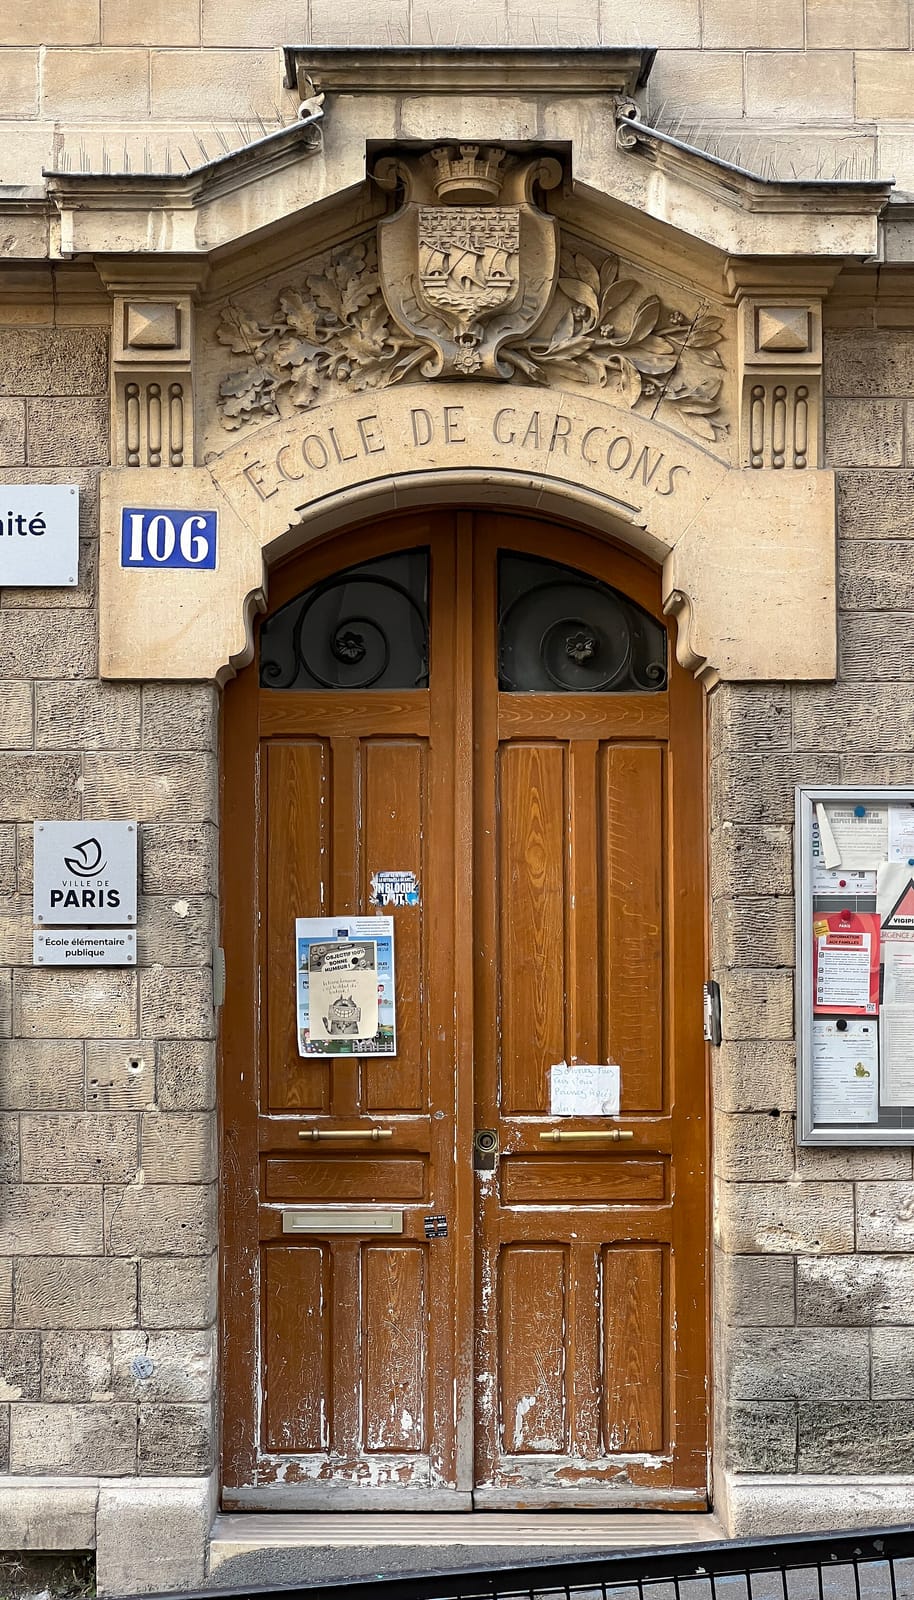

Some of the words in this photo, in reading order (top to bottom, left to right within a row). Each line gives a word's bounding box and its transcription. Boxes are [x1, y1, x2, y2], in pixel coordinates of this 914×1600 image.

[243, 414, 386, 502] ECOLE
[411, 406, 466, 446] DE
[129, 514, 209, 563] 106
[50, 890, 121, 908] PARIS
[45, 937, 70, 946] École
[71, 937, 126, 946] élémentaire
[65, 947, 105, 958] publique
[326, 951, 351, 961] OBJECTIF
[329, 958, 348, 966] BONNE
[324, 964, 348, 972] HUMEUR
